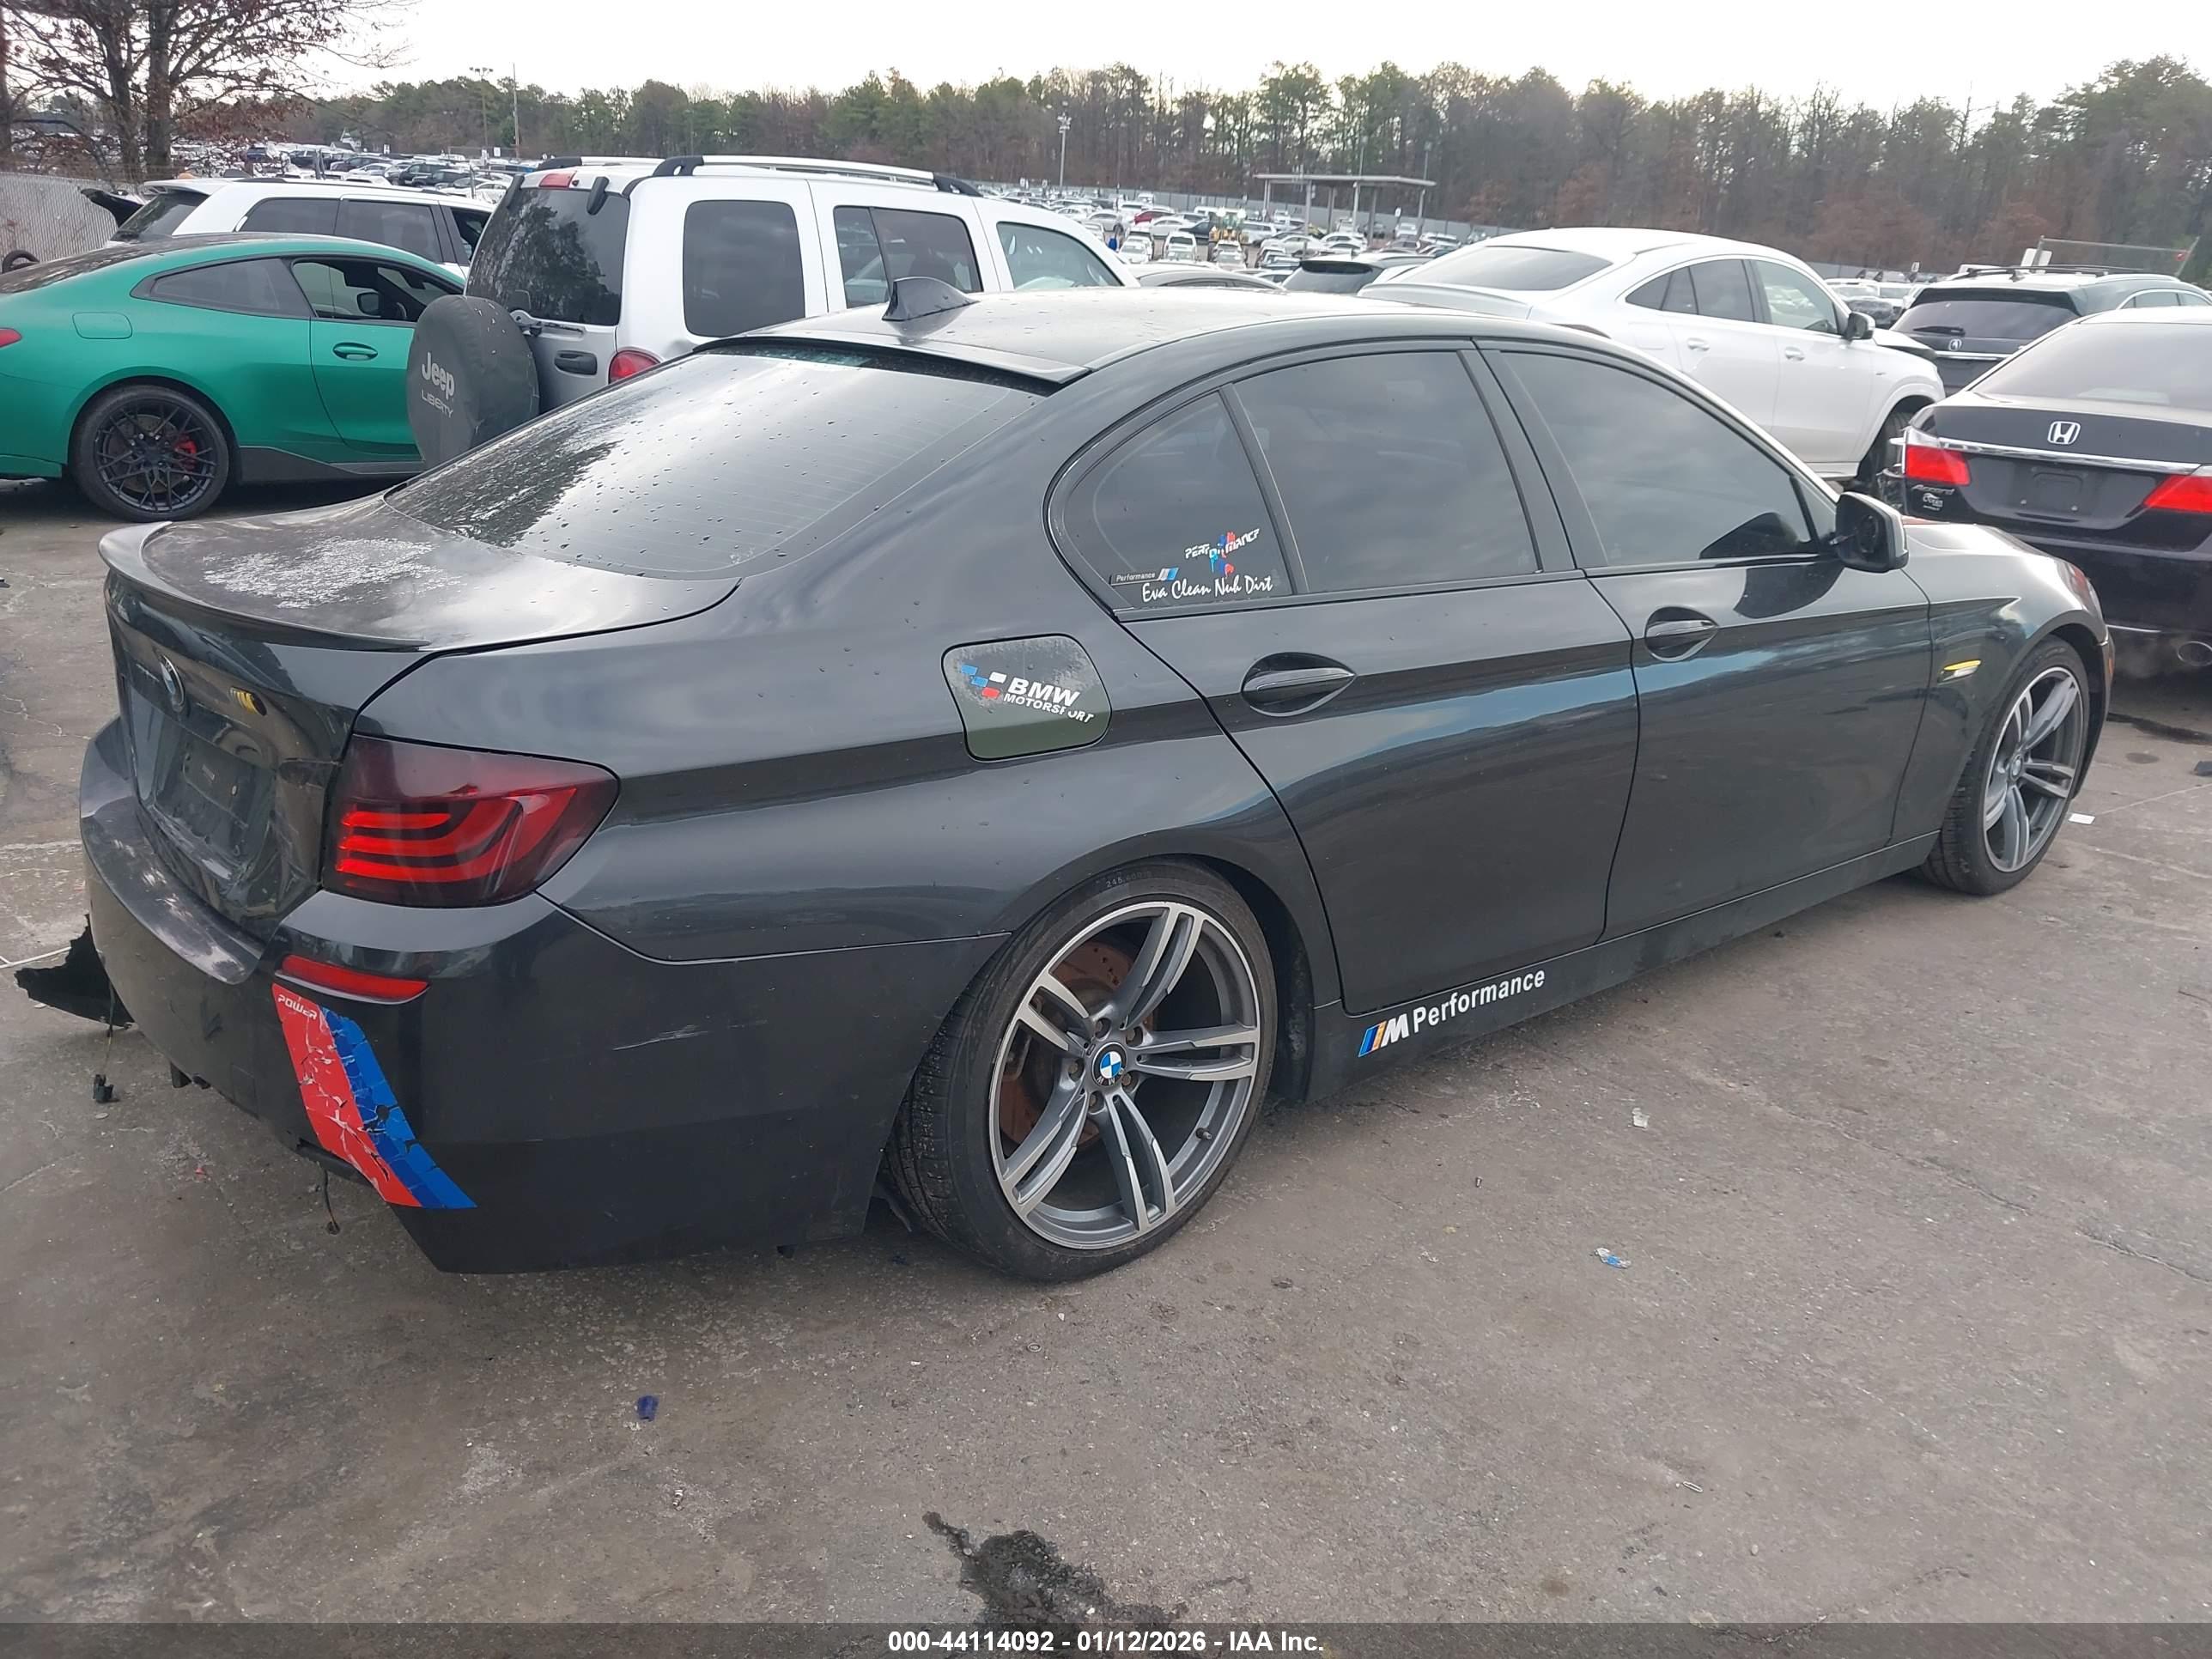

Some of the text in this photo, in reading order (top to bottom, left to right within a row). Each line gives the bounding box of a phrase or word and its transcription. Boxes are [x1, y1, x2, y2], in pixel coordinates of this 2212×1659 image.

[421, 351, 455, 401] Jeep
[421, 388, 454, 418] LIBERTY
[1115, 573, 1156, 582] Performance
[1142, 574, 1273, 602] Eva Clean Nuh Dirt
[1007, 677, 1080, 707] BMW
[1413, 969, 1546, 1034] Performance
